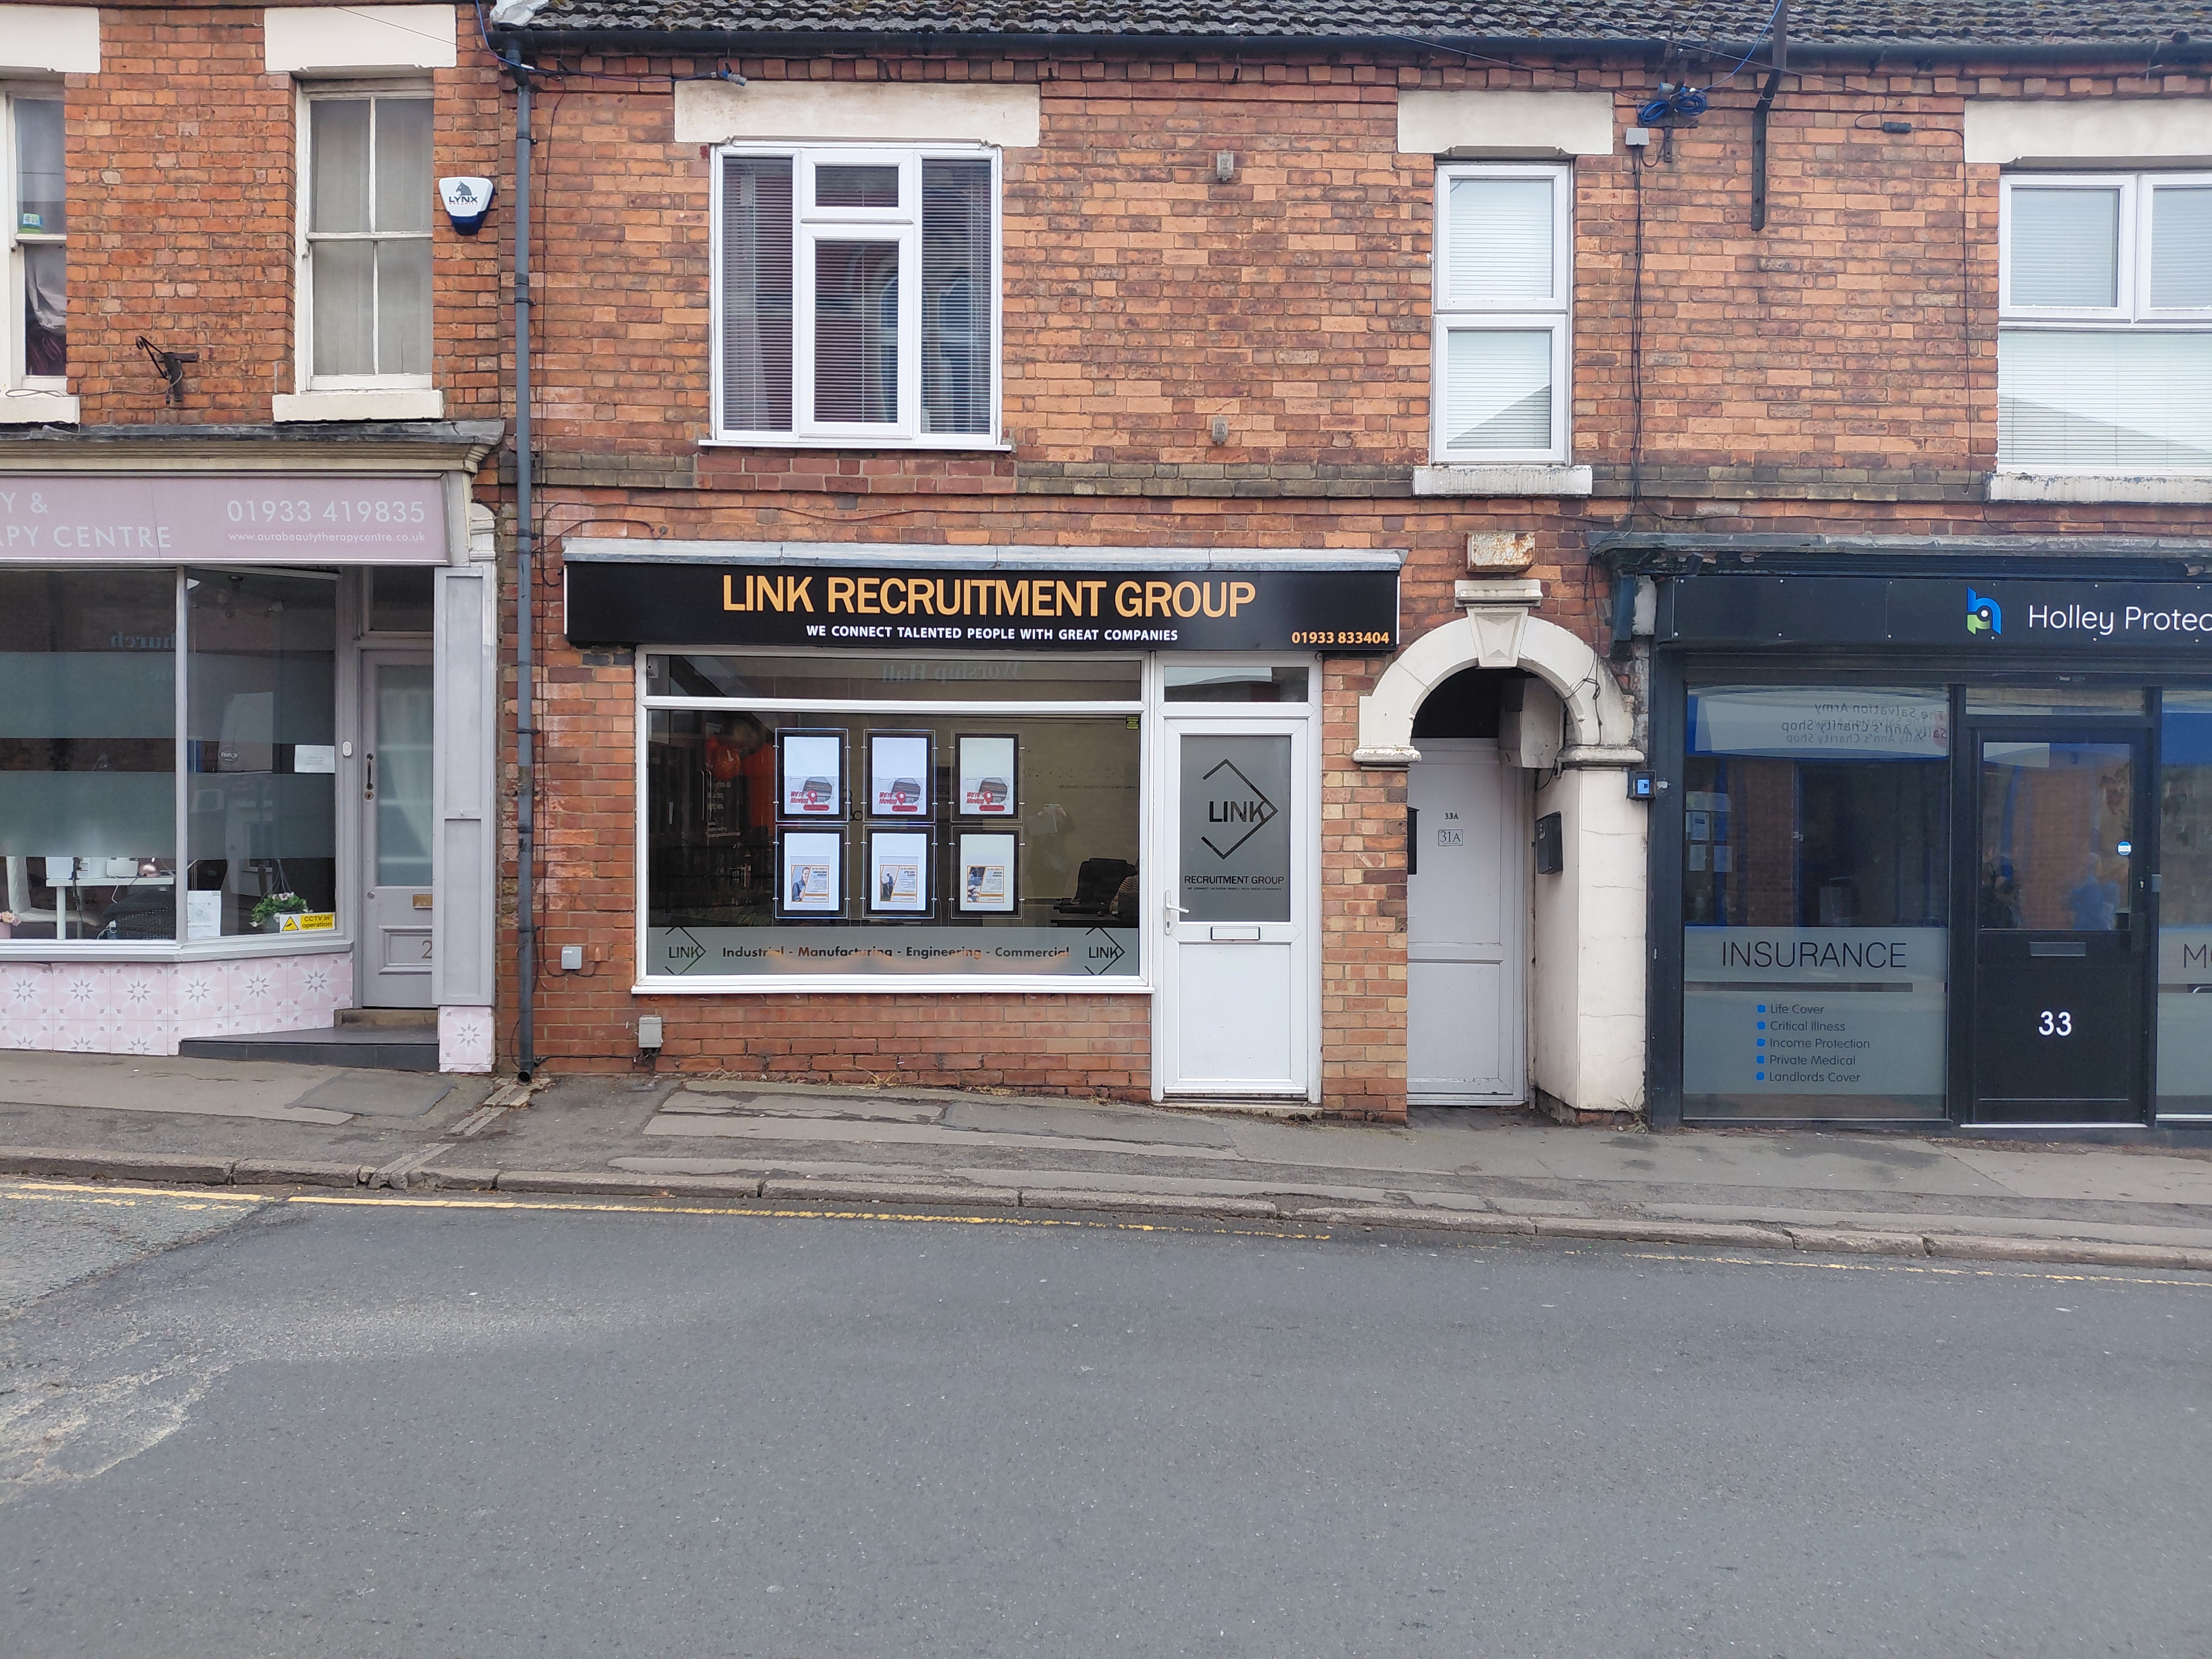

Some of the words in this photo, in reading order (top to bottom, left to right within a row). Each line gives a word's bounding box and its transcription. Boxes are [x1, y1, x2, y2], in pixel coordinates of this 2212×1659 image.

[0, 492, 16, 513] Y
[30, 492, 49, 513] &
[227, 500, 311, 522] 01933
[323, 501, 425, 523] 419835
[0, 526, 38, 546] PY
[54, 526, 171, 548] CENTRE
[228, 531, 425, 543] www.aurabeautytherapycentre.co.uk
[722, 575, 814, 613] LINK
[827, 576, 1107, 617] RECRUITMENT
[1115, 581, 1256, 618] GROUP
[2029, 604, 2114, 635] Holley
[2125, 606, 2212, 631] Protec
[806, 625, 826, 636] WE
[831, 626, 892, 638] CONNECT
[897, 627, 962, 639] TALENTED
[967, 627, 1015, 640] PEOPLE
[1020, 628, 1053, 640] WITH
[1058, 629, 1099, 640] GREAT
[1104, 629, 1178, 641] COMPANIES
[1291, 631, 1334, 644] 01933
[1338, 632, 1390, 645] 833404
[1209, 801, 1265, 822] LINK
[1440, 831, 1461, 843] 31A
[1184, 876, 1249, 884] RECRUITMENT
[1251, 876, 1285, 885] GROUP
[668, 946, 699, 959] LINK
[723, 946, 784, 957] Industrl
[906, 946, 981, 960] Engineering
[995, 946, 1069, 957] Commercial
[1088, 946, 1120, 959] LINK
[1722, 941, 1907, 968] INSURANCE
[2183, 943, 2212, 969] M
[1771, 1004, 1789, 1014] Life
[1792, 1004, 1824, 1014] Cover
[1770, 1021, 1808, 1031] Critical
[1811, 1021, 1846, 1031] Illness
[2039, 1011, 2072, 1036] 33
[1770, 1038, 1812, 1048] Income
[1815, 1038, 1870, 1049] Protection
[1770, 1054, 1808, 1065] Private
[1811, 1055, 1856, 1065] Medical
[1770, 1071, 1825, 1082] Landlords
[1828, 1072, 1861, 1082] Cover
